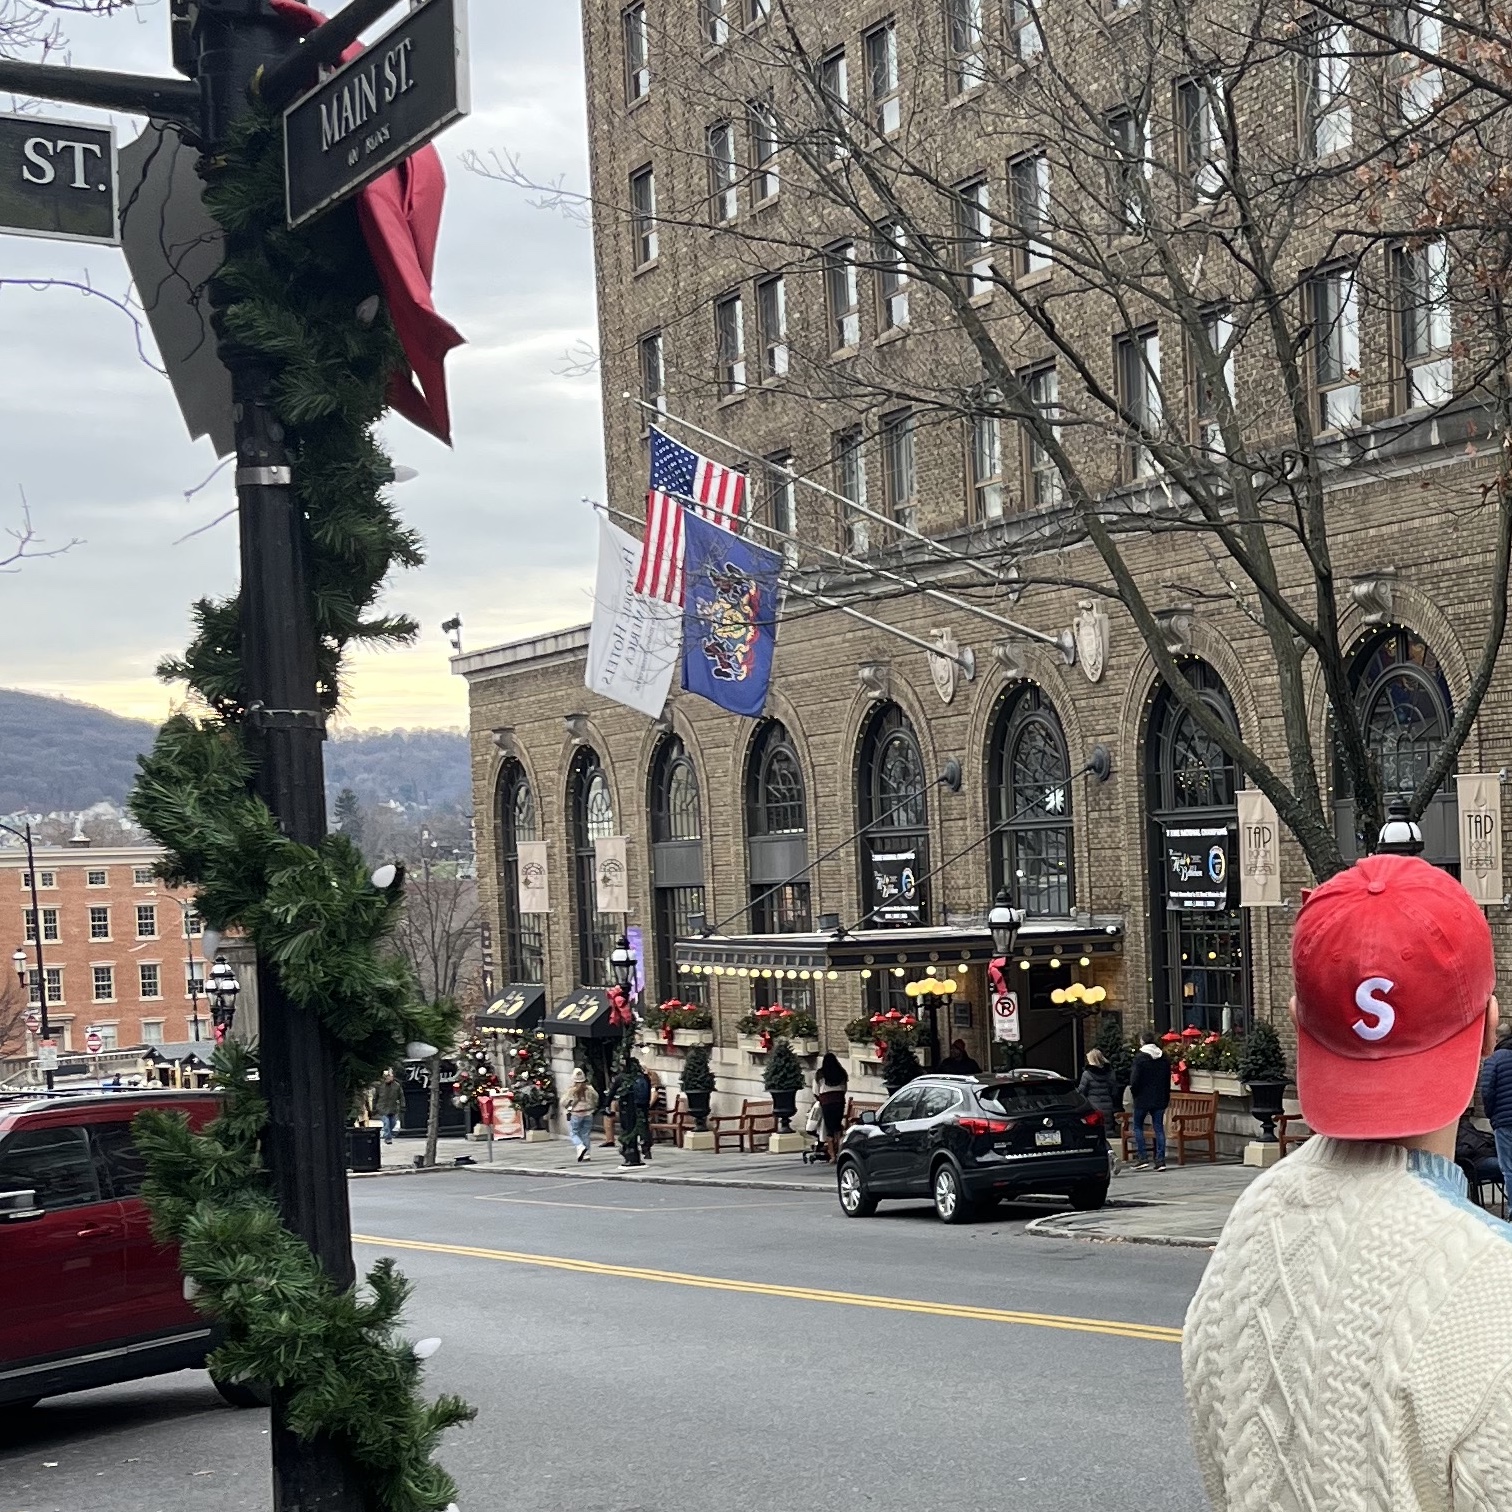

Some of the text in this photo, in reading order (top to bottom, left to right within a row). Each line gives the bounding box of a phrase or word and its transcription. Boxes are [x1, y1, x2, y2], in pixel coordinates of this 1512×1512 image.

[320, 64, 377, 152] MAIN
[384, 37, 414, 103] ST.
[22, 137, 107, 192] ST.
[1246, 826, 1272, 849] TAP
[1466, 814, 1494, 839] TAP
[1352, 977, 1395, 1041] S
